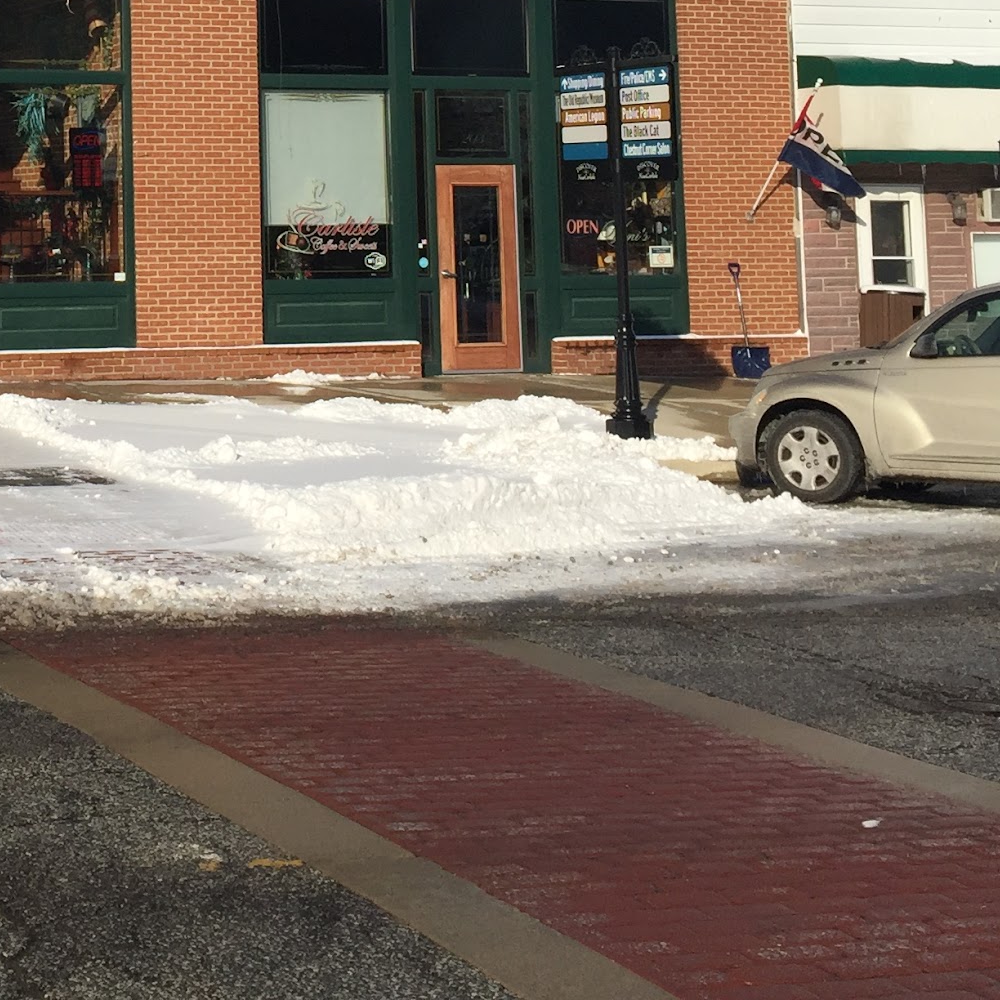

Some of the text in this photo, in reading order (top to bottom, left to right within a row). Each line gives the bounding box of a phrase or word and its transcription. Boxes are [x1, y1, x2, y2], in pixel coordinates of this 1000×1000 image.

[621, 89, 650, 102] Post Office
[565, 110, 605, 124] American Legion
[622, 105, 662, 120] Public Parking
[623, 123, 660, 138] The Black Cat
[74, 134, 102, 147] OPEN
[297, 214, 380, 237] Carlisle
[566, 218, 599, 234] OPEN
[338, 240, 348, 251] &
